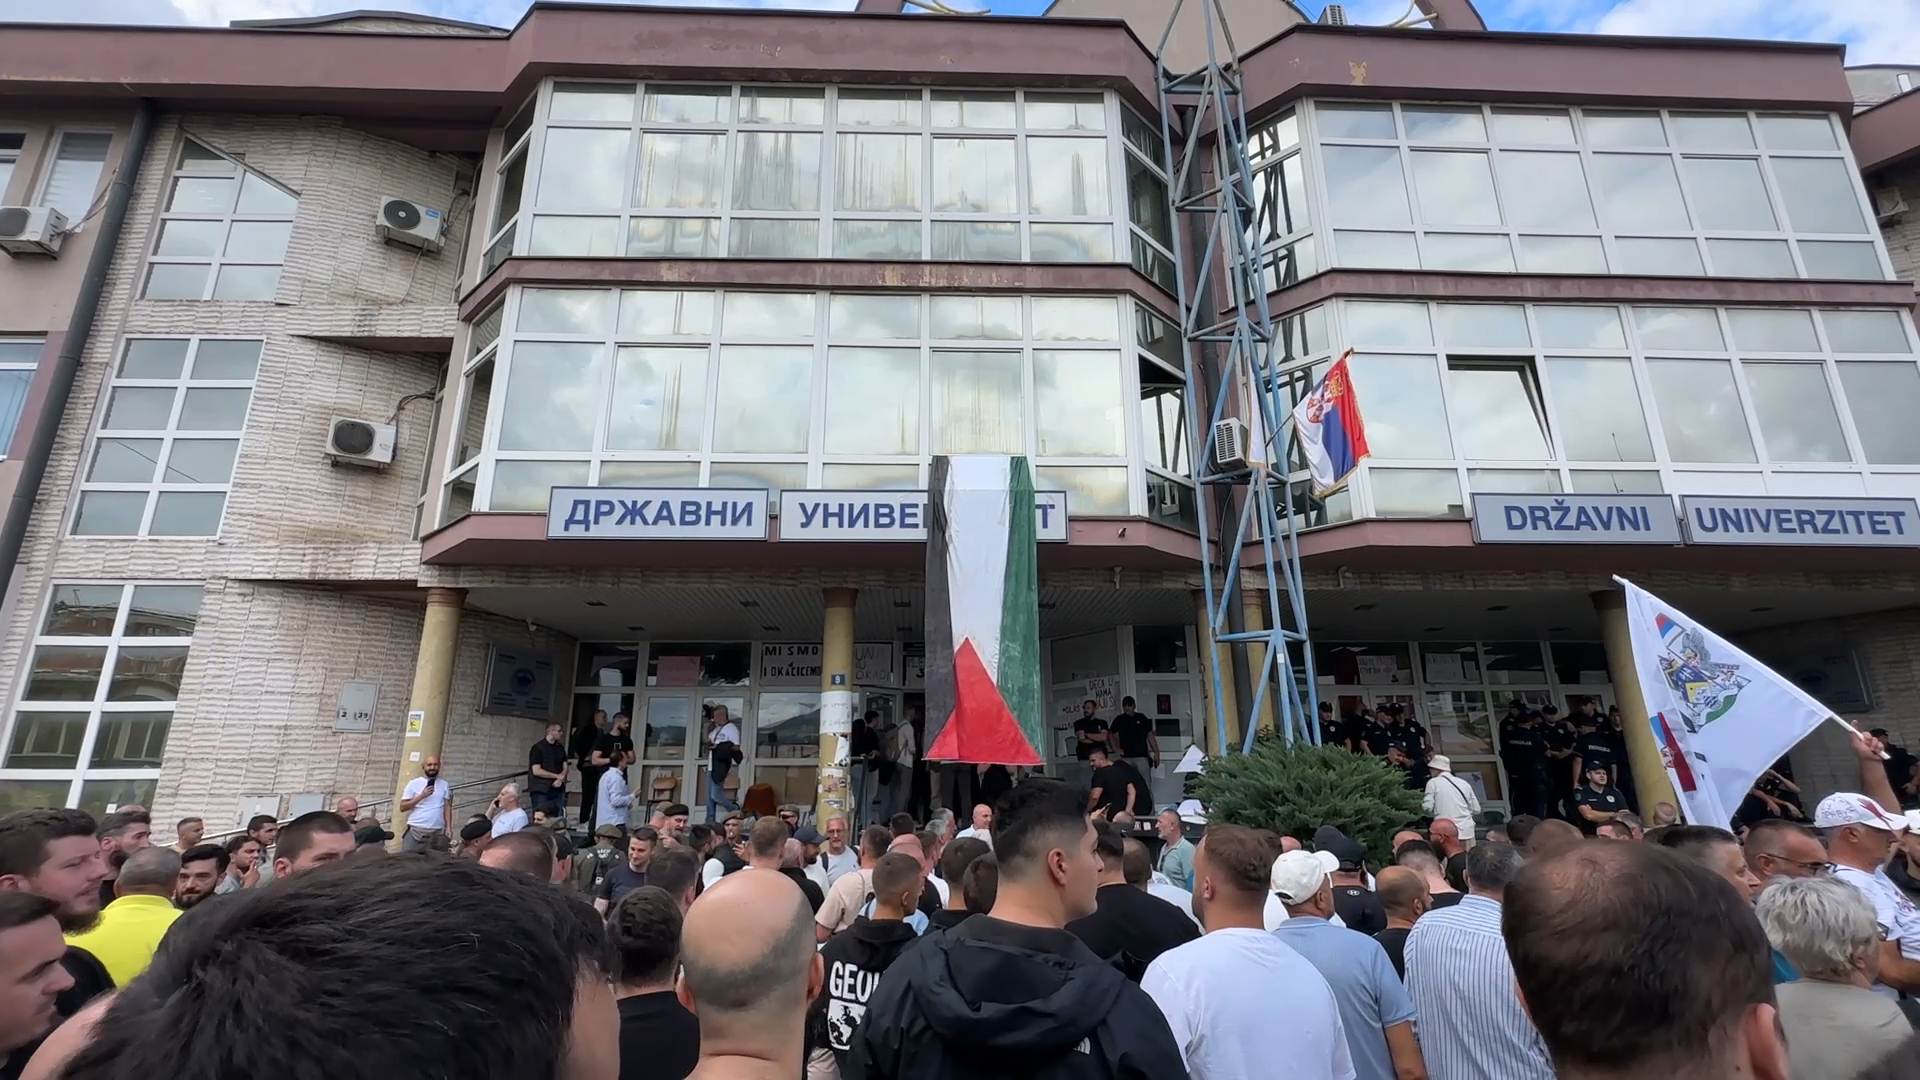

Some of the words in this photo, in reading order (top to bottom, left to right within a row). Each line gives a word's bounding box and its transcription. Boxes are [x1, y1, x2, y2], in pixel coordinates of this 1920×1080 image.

[563, 499, 754, 532] ДРЖАВНИ
[798, 502, 1056, 529] УНИВЕТ
[1504, 498, 1652, 531] DRŽAVNI
[1694, 507, 1906, 535] UNIVERZITET
[765, 646, 782, 656] MI
[787, 646, 818, 656] SMO
